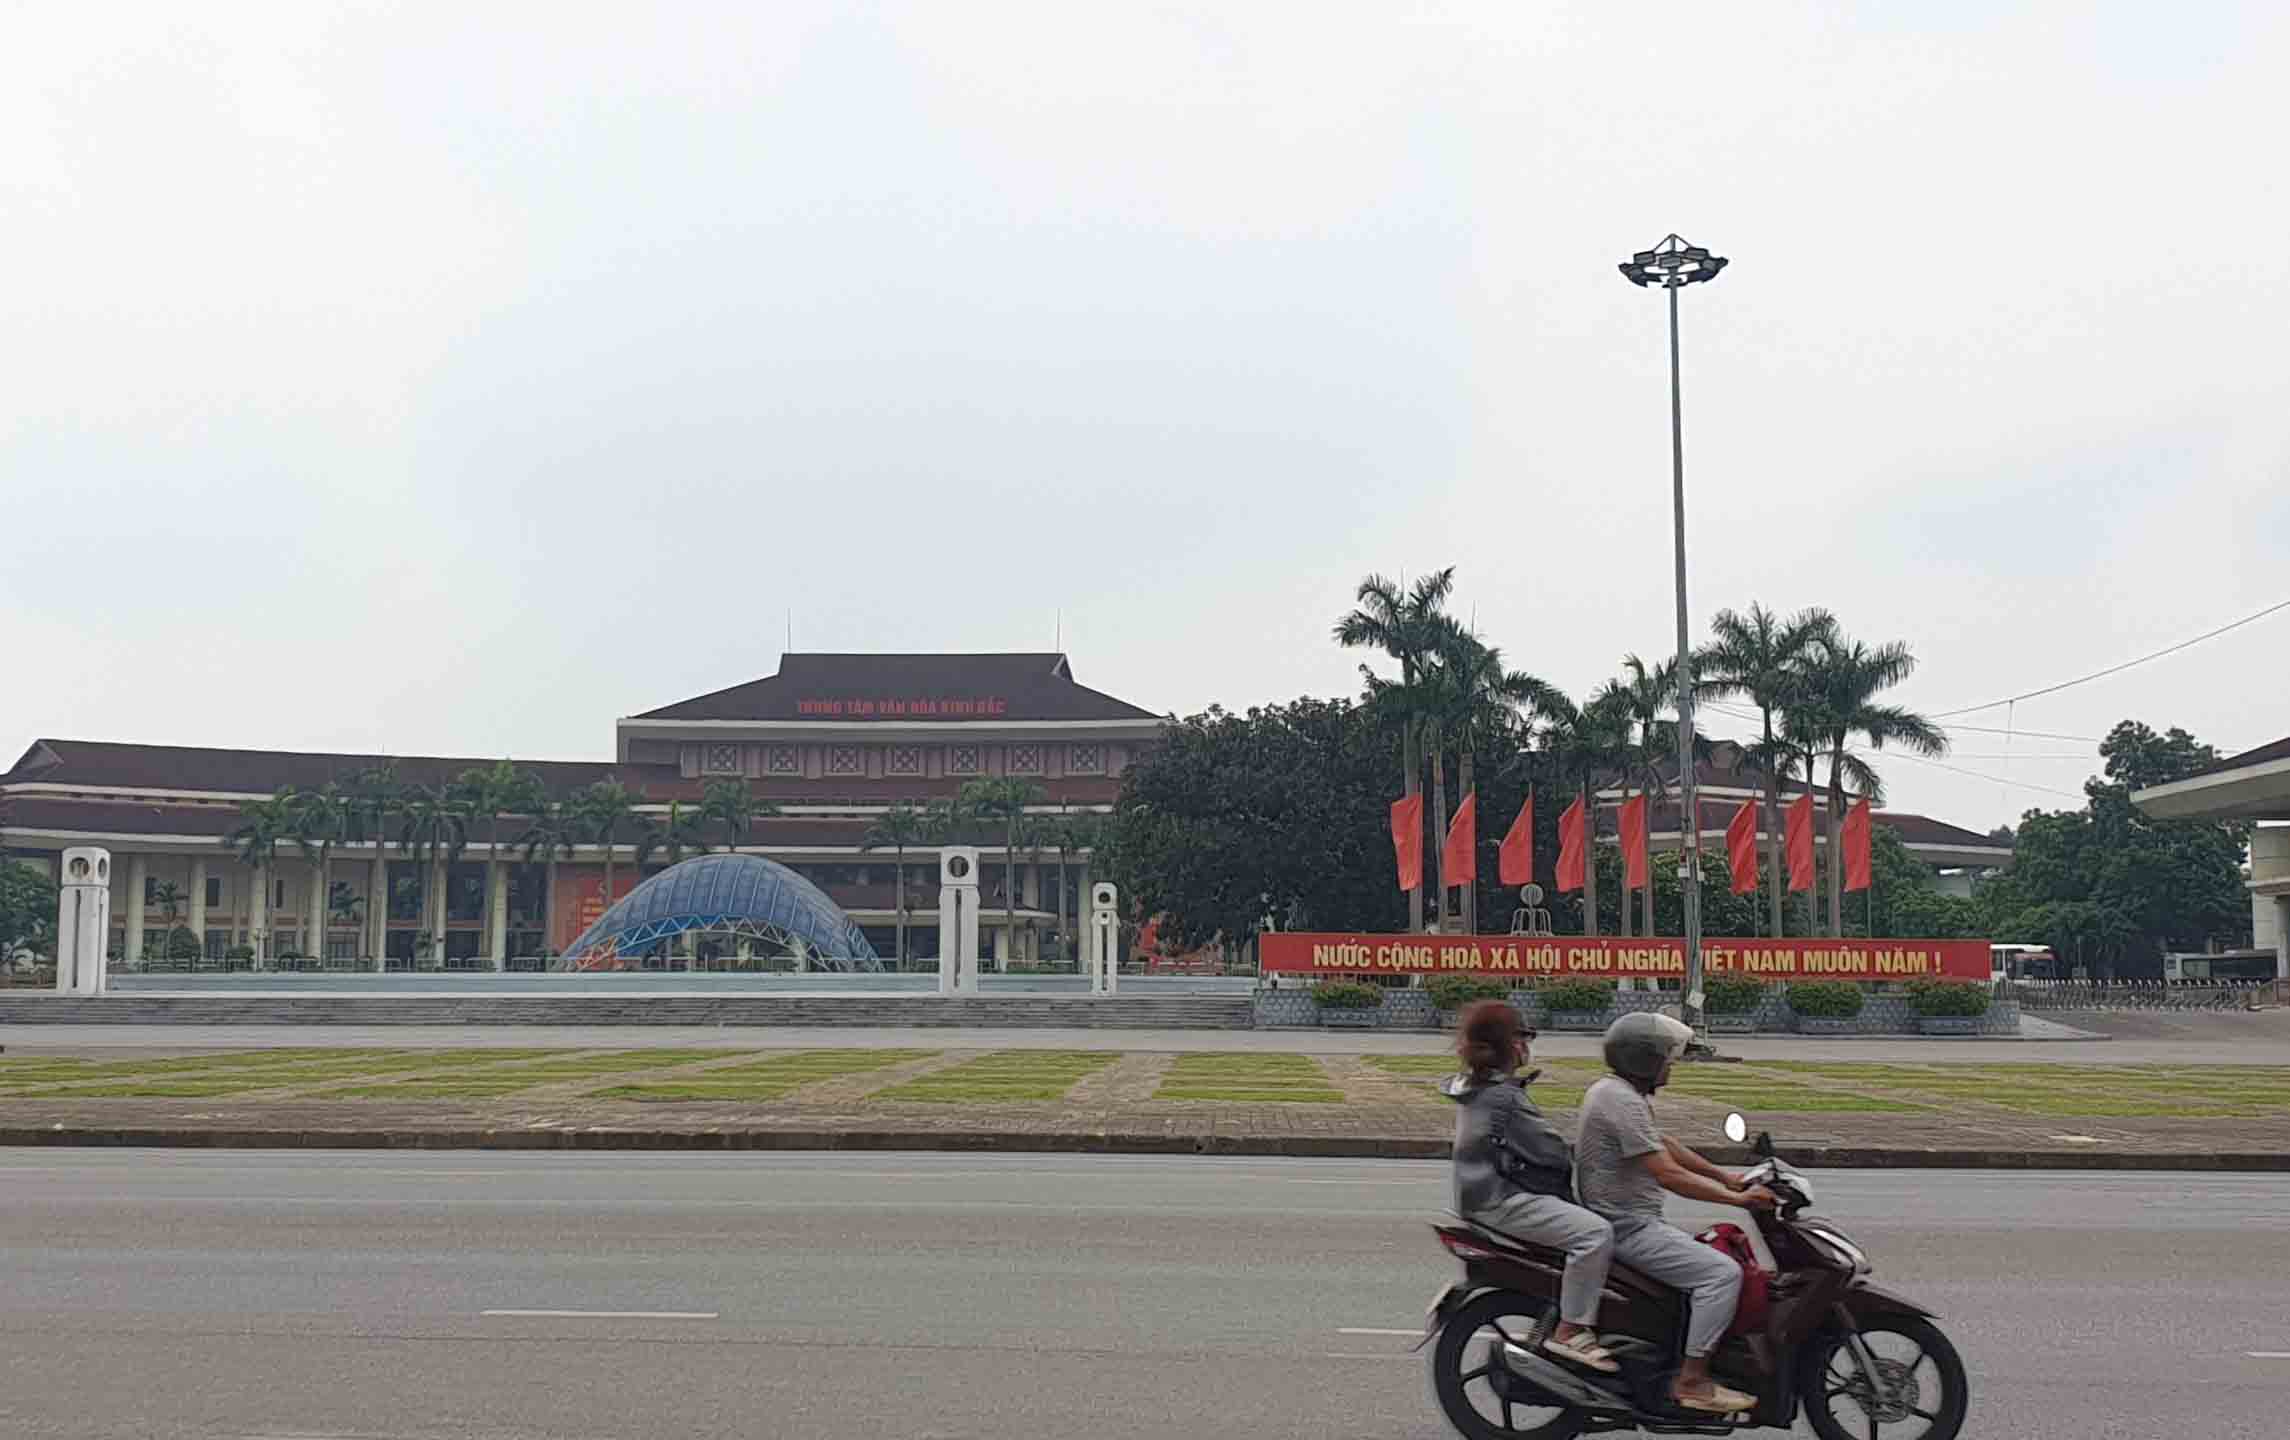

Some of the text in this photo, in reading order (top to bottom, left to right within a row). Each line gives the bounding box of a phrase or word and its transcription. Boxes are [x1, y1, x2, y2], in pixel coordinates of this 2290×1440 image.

[1313, 938, 1370, 967] NƯỚC
[1376, 942, 1434, 971] CỘNG
[1440, 943, 1483, 969] HOÀ
[1490, 944, 1519, 970] XÃ
[1526, 943, 1560, 973] HỘI
[1567, 940, 1611, 970] CHỦ
[1617, 944, 1684, 971] NGHĨA
[1743, 949, 1796, 972] NAM
[1803, 946, 1867, 973] MUÔN
[1875, 947, 1927, 973] NĂM
[1934, 951, 1942, 973] !
